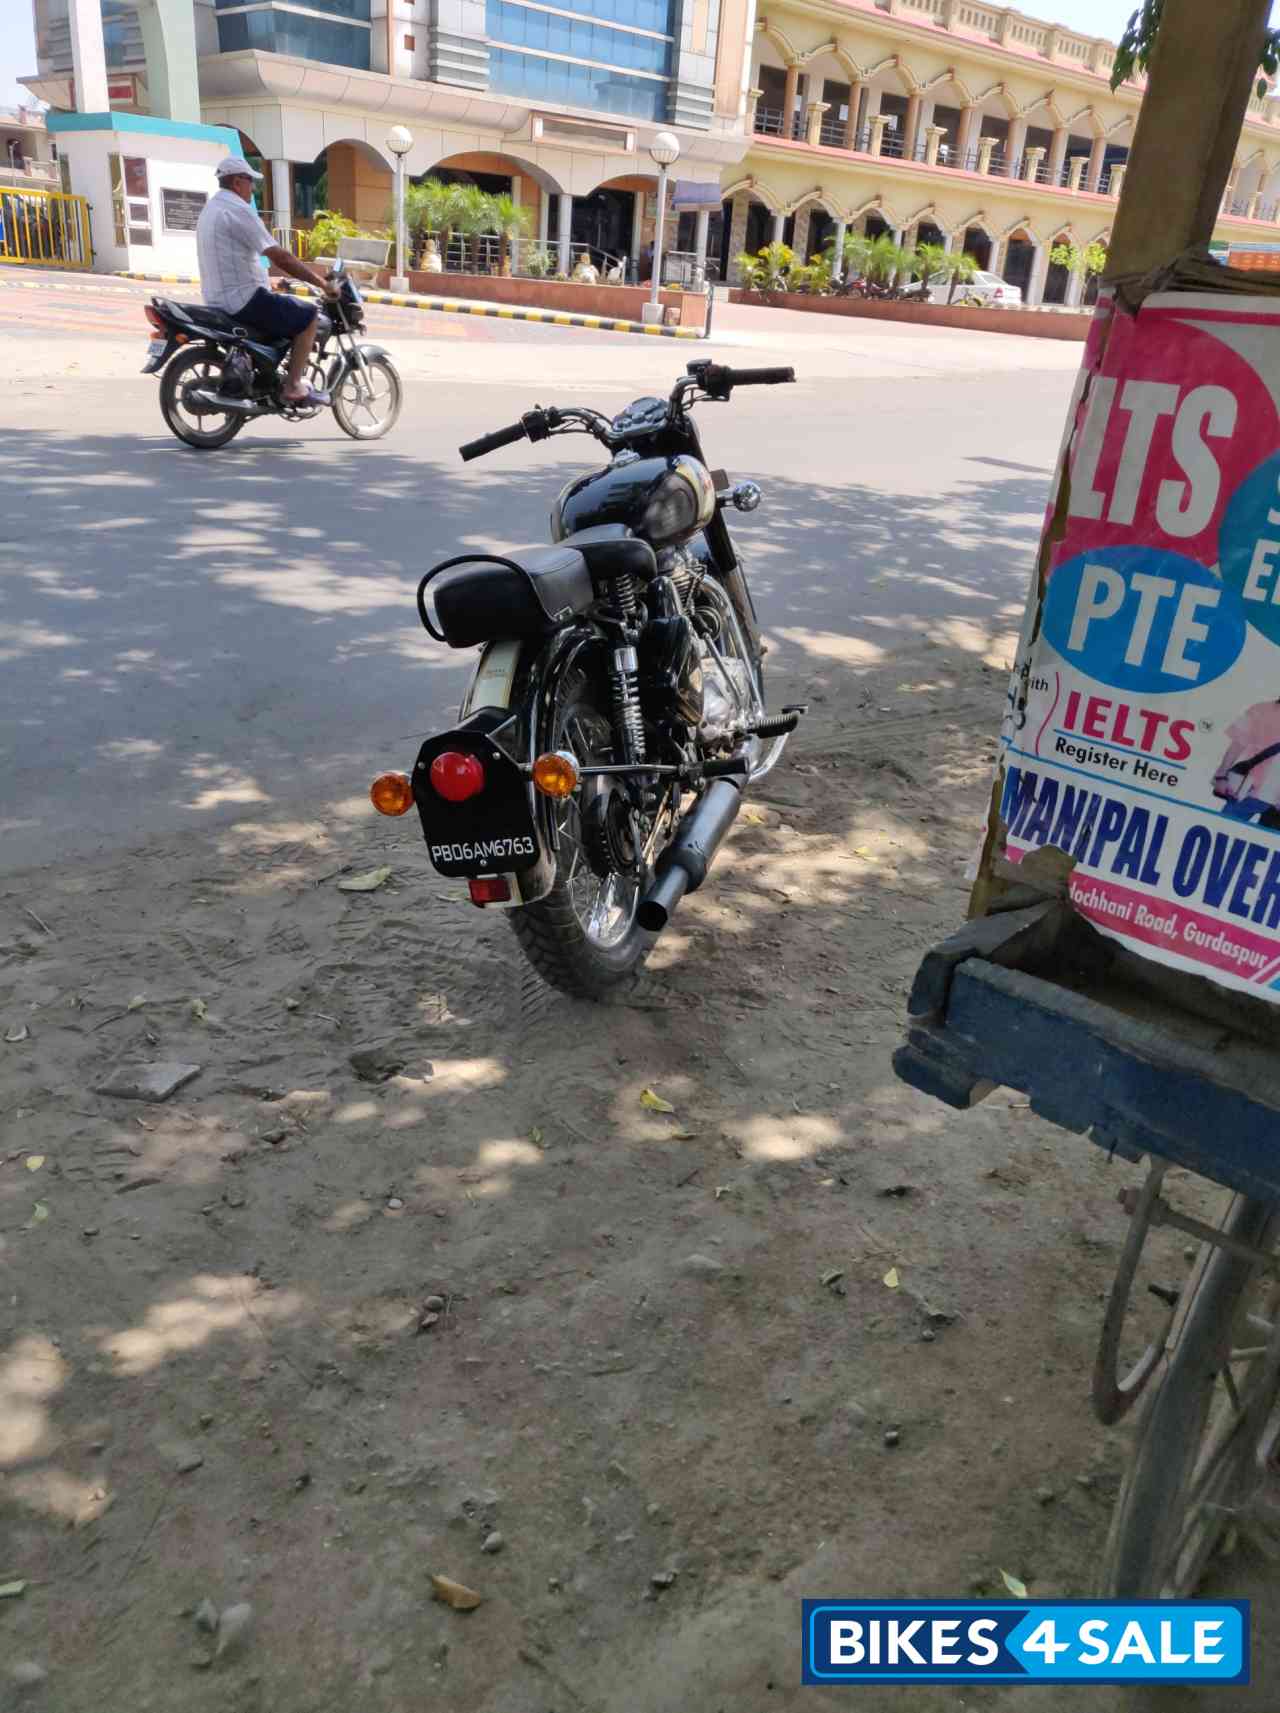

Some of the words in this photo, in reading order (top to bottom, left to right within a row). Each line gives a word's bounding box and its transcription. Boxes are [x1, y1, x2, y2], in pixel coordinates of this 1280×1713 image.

[1066, 564, 1223, 682] PTE
[1055, 736, 1129, 773] Register
[1133, 761, 1179, 788] Here
[1063, 690, 1196, 762] IELTS
[1000, 765, 1169, 888] MANIPAL
[1134, 902, 1179, 940] Road,
[1183, 920, 1269, 970] Gurdaspur
